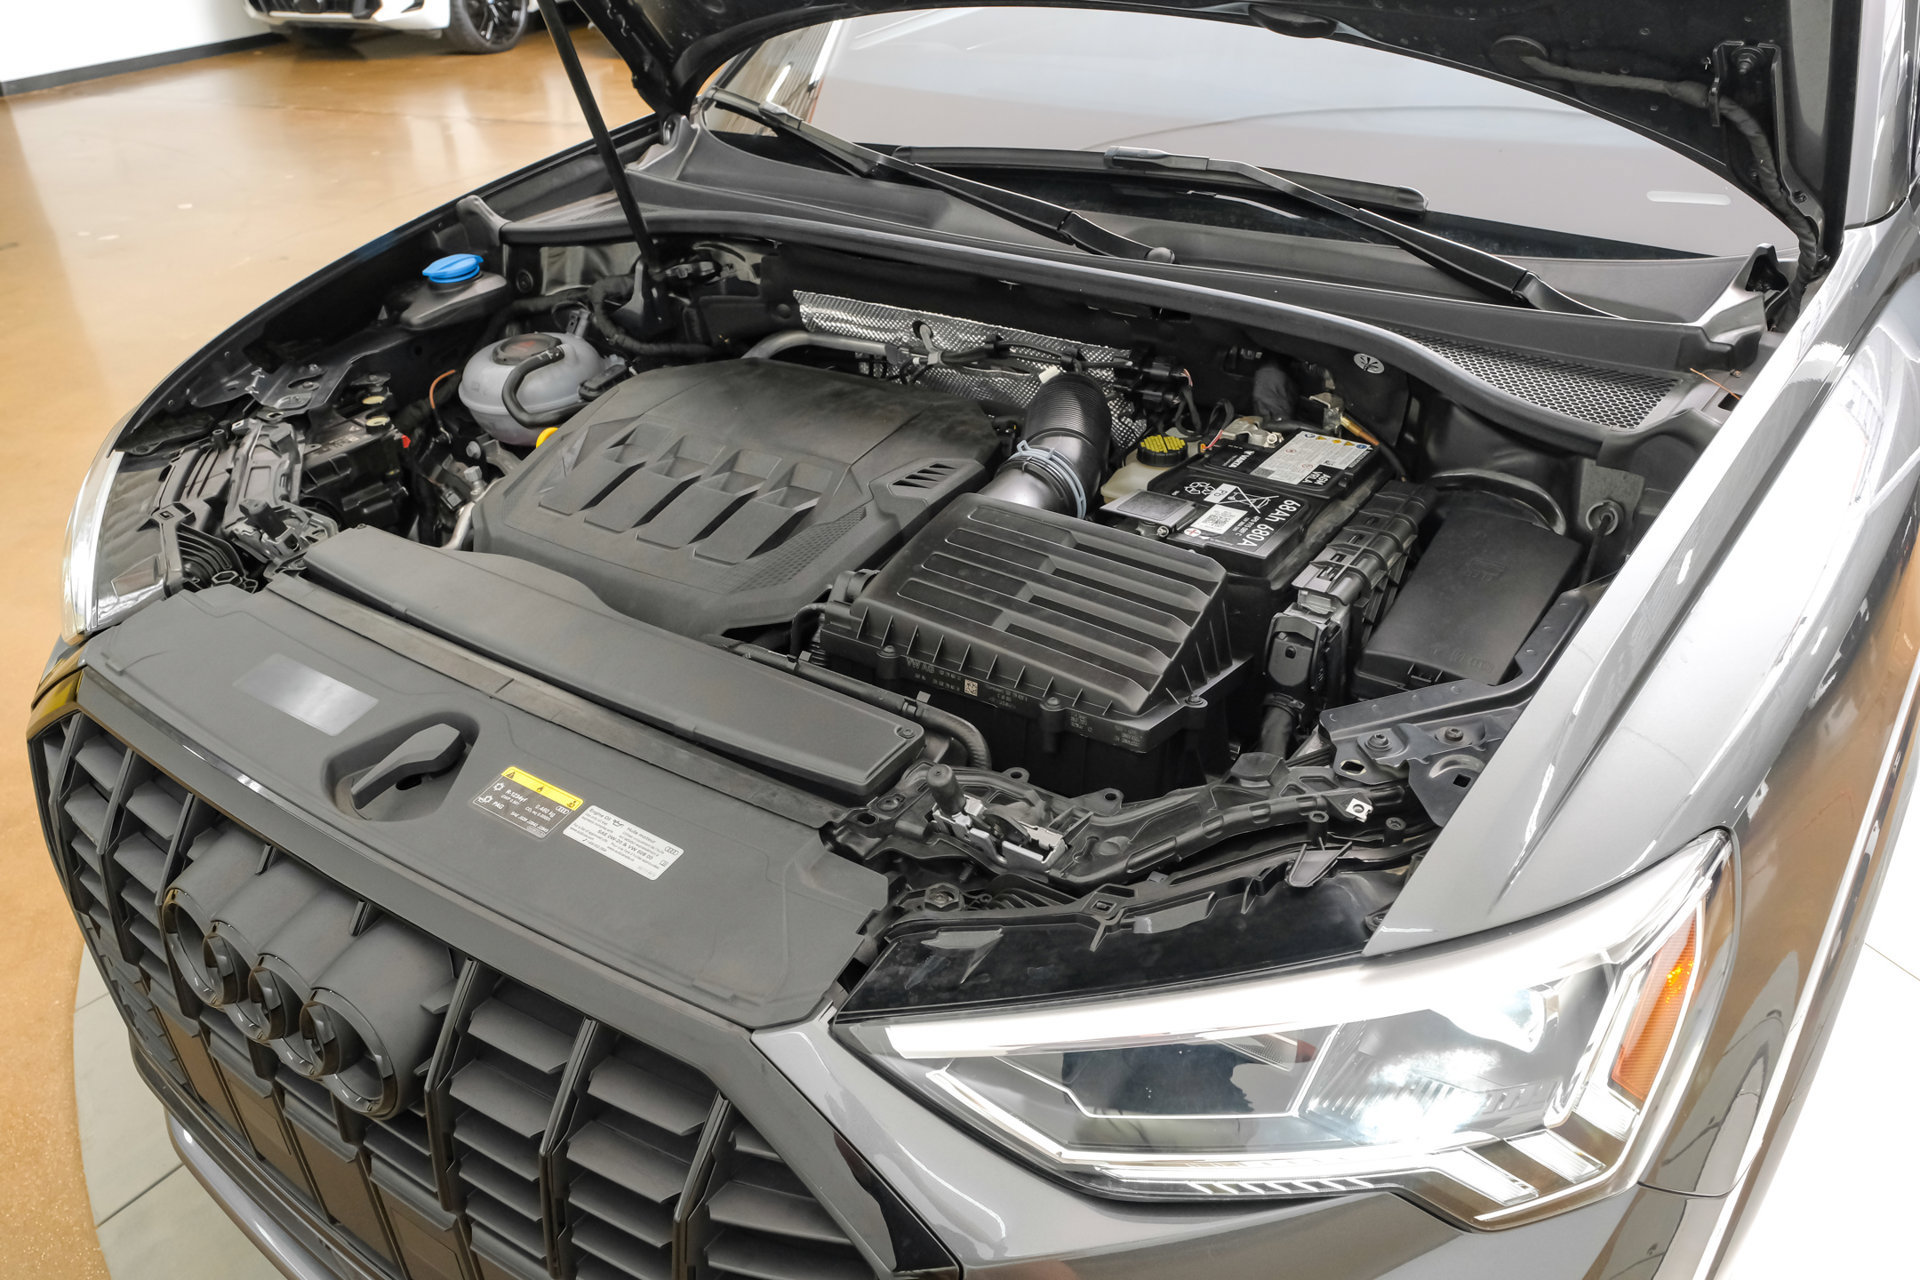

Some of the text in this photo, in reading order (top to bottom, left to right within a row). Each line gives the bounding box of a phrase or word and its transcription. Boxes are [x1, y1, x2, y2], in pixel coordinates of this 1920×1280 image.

[1314, 473, 1331, 486] AGM
[1265, 499, 1301, 522] 68Ah
[1236, 523, 1275, 547] 680A
[492, 800, 505, 810] PAG
